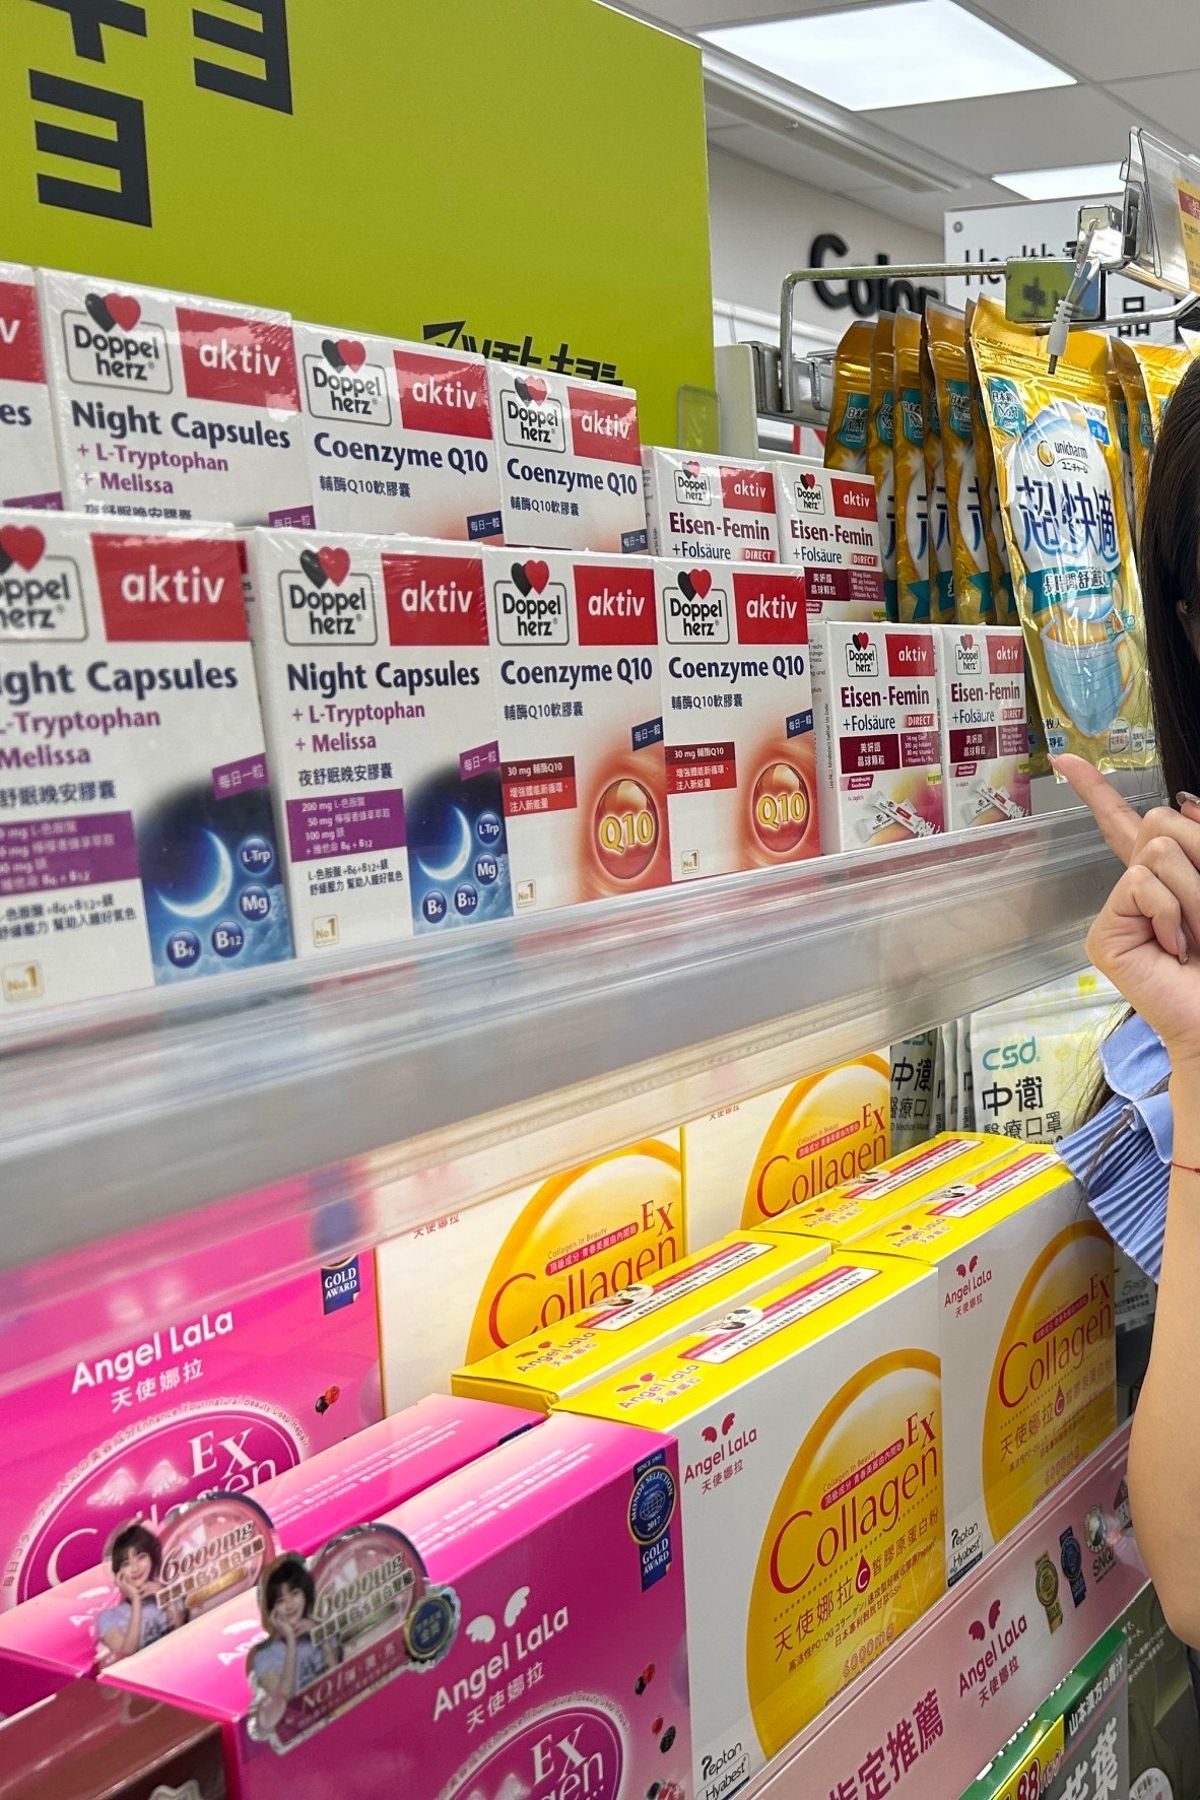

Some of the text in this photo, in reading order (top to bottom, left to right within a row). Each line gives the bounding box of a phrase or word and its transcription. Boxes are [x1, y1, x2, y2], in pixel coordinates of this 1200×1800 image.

[74, 325, 159, 359] Doppel
[95, 353, 147, 381] herz
[199, 338, 281, 376] aktiv
[313, 366, 381, 397] Doppel
[412, 379, 477, 410] aktiv
[331, 394, 372, 415] herz
[508, 401, 559, 427] Doppel
[71, 400, 161, 439] Night
[171, 413, 291, 449] Capsules
[520, 421, 551, 444] herz
[581, 413, 630, 440] aktiv
[96, 443, 228, 473] L-Tryptophan
[314, 432, 488, 475] Coenzyme Q10
[1054, 441, 1088, 459] unicharm
[100, 472, 173, 494] Melissa
[507, 458, 637, 495] Coenzyme Q10
[678, 477, 707, 491] Doppel
[685, 490, 703, 501] herz
[734, 482, 766, 498] aktiv
[797, 487, 821, 500] Doppel
[843, 493, 870, 507] aktiv
[803, 499, 818, 510] herz
[669, 512, 770, 541] Eisen-Femin
[1017, 474, 1119, 562] 超快適
[791, 520, 873, 546] Eisen-Femin
[745, 551, 771, 561] DIRECT
[853, 556, 875, 565] DIRECT
[0, 574, 71, 606] ppel
[121, 564, 224, 603] aktiv
[401, 581, 472, 612] aktiv
[290, 584, 366, 615] Doppel
[503, 593, 561, 619] Doppel
[588, 588, 645, 616] aktiv
[670, 598, 722, 621] Doppel
[746, 594, 797, 618] aktiv
[310, 611, 355, 635] herz
[518, 617, 552, 636] herz
[684, 619, 714, 636] herz
[850, 650, 874, 665] Doppel
[856, 662, 871, 672] herz
[899, 646, 927, 662] aktiv
[957, 650, 978, 664] Doppel
[963, 661, 977, 671] herz
[997, 648, 1018, 660] aktiv
[0, 659, 238, 704] ght Capsules
[287, 660, 480, 699] Night Capsules
[501, 657, 652, 690] Coenzyme Q10
[669, 657, 768, 683] Coenzyme
[773, 656, 804, 679] Q10
[841, 684, 930, 707] Eisen-Femin
[951, 681, 1020, 702] Eisen-Femin
[309, 701, 425, 727] L-Tryptophan
[908, 715, 931, 726] DIRECT
[1003, 709, 1021, 719] DIRECT
[312, 732, 376, 752] Melissa
[674, 750, 683, 759] 30
[684, 750, 695, 759] mg
[0, 744, 91, 769] Melissa
[508, 767, 517, 775] 30
[519, 767, 531, 777] mg
[757, 793, 805, 829] Q10
[479, 823, 499, 836] L-Trp
[601, 812, 653, 853] Q10
[477, 864, 496, 877] Mg
[243, 895, 268, 912] Mg
[428, 900, 442, 914] B6
[458, 893, 476, 907] B12
[215, 931, 241, 949] B12
[982, 1037, 1036, 1070] csd
[982, 1076, 1043, 1116] 中衛
[757, 1135, 886, 1217] Collagen
[324, 1266, 357, 1289] GOLD
[325, 1279, 357, 1300] AWARD
[944, 1269, 993, 1308] Angel LaLa
[489, 1237, 675, 1349] Collagen
[71, 1311, 234, 1394] Angel LaLa
[999, 1302, 1111, 1408] Collagen
[111, 1359, 204, 1414] 天使娜拉
[684, 1427, 757, 1484] Angel LaLa
[702, 1460, 743, 1495] 天使娜拉
[647, 1516, 660, 1531] 2017
[770, 1445, 938, 1594] Collagen
[951, 1522, 978, 1548] Peptan
[643, 1538, 668, 1564] GOLD
[644, 1551, 669, 1575] AWARD
[774, 1575, 854, 1662] 天使娜拉
[433, 1642, 508, 1721] Angel
[516, 1606, 569, 1660] LaLa
[958, 1614, 1028, 1698] Angel LaLa
[978, 1655, 1020, 1707] 天使娜拉
[467, 1661, 545, 1733] 天使娜拉
[701, 1742, 742, 1781] Peptan
